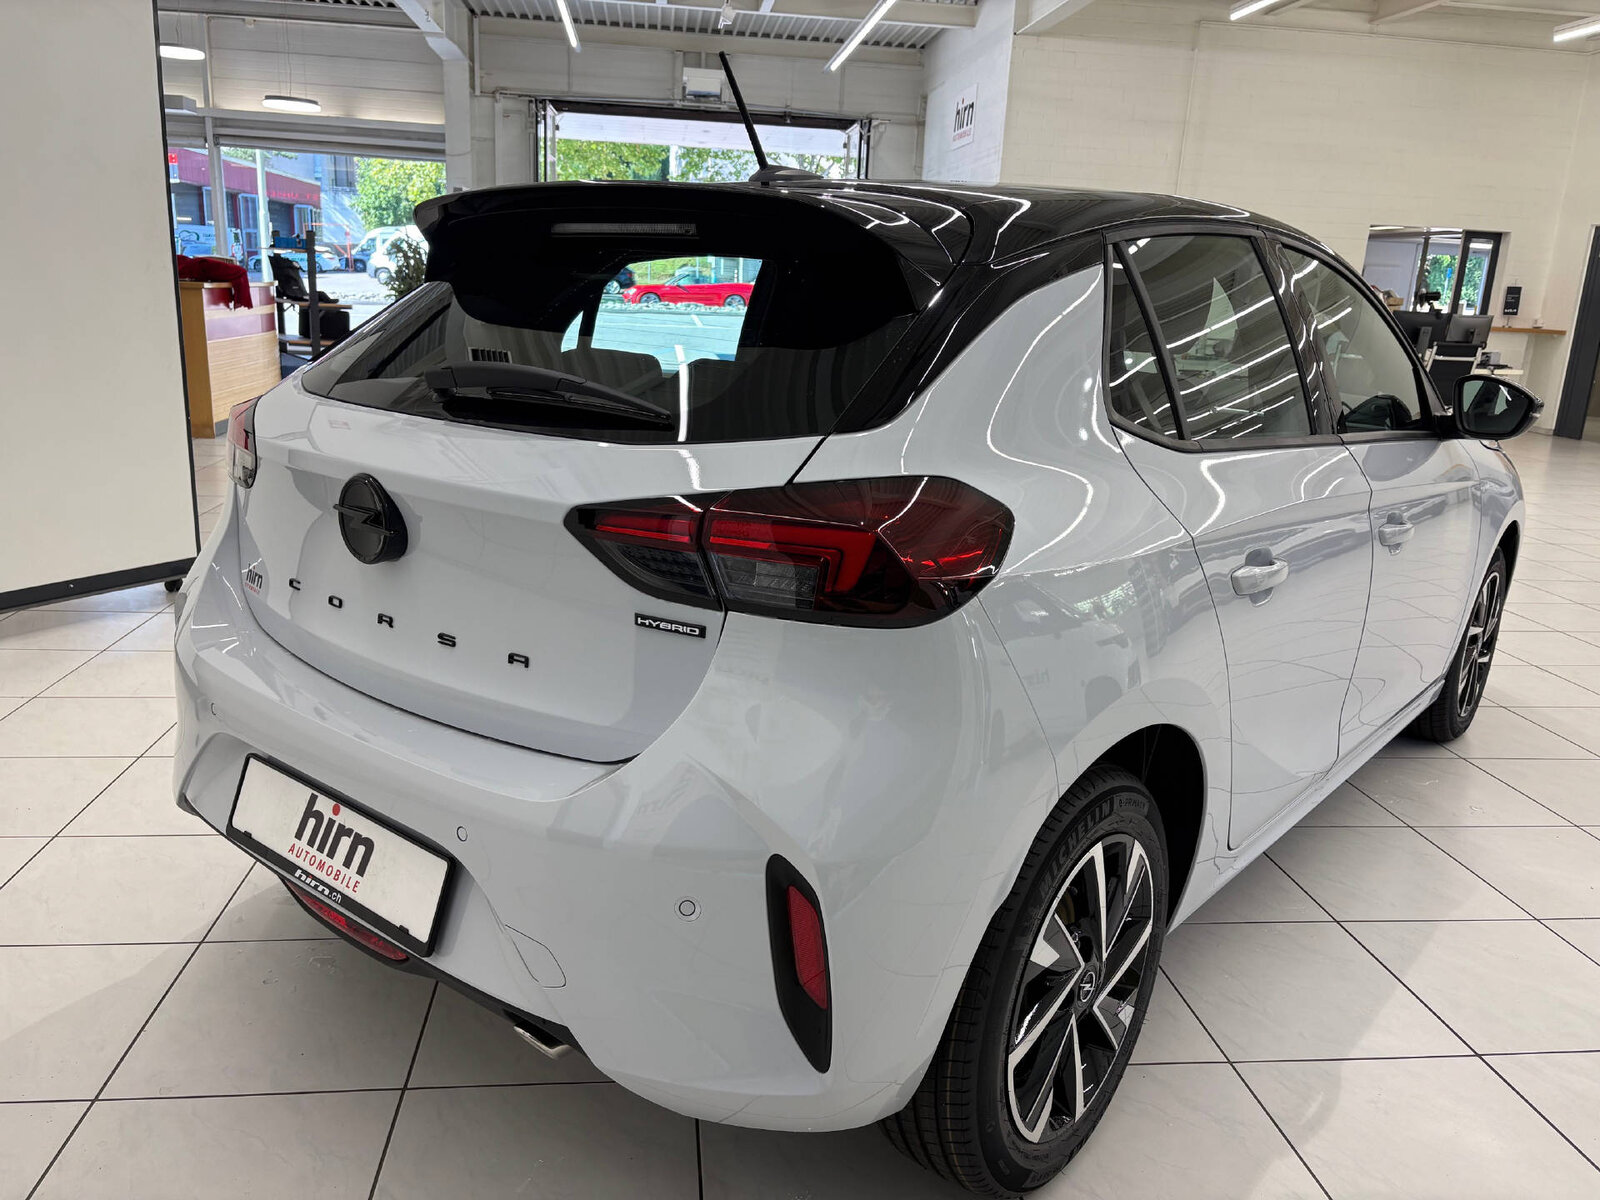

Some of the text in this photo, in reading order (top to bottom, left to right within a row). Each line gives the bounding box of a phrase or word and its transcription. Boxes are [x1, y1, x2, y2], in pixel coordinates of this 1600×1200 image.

[953, 97, 975, 133] hirn
[288, 577, 530, 668] CORSA
[637, 617, 700, 635] HYBRID
[294, 792, 375, 878] hirn
[1038, 798, 1112, 899] MICHELIN
[287, 842, 361, 893] AUTOMOBILE
[294, 868, 342, 904] hirn.ch
